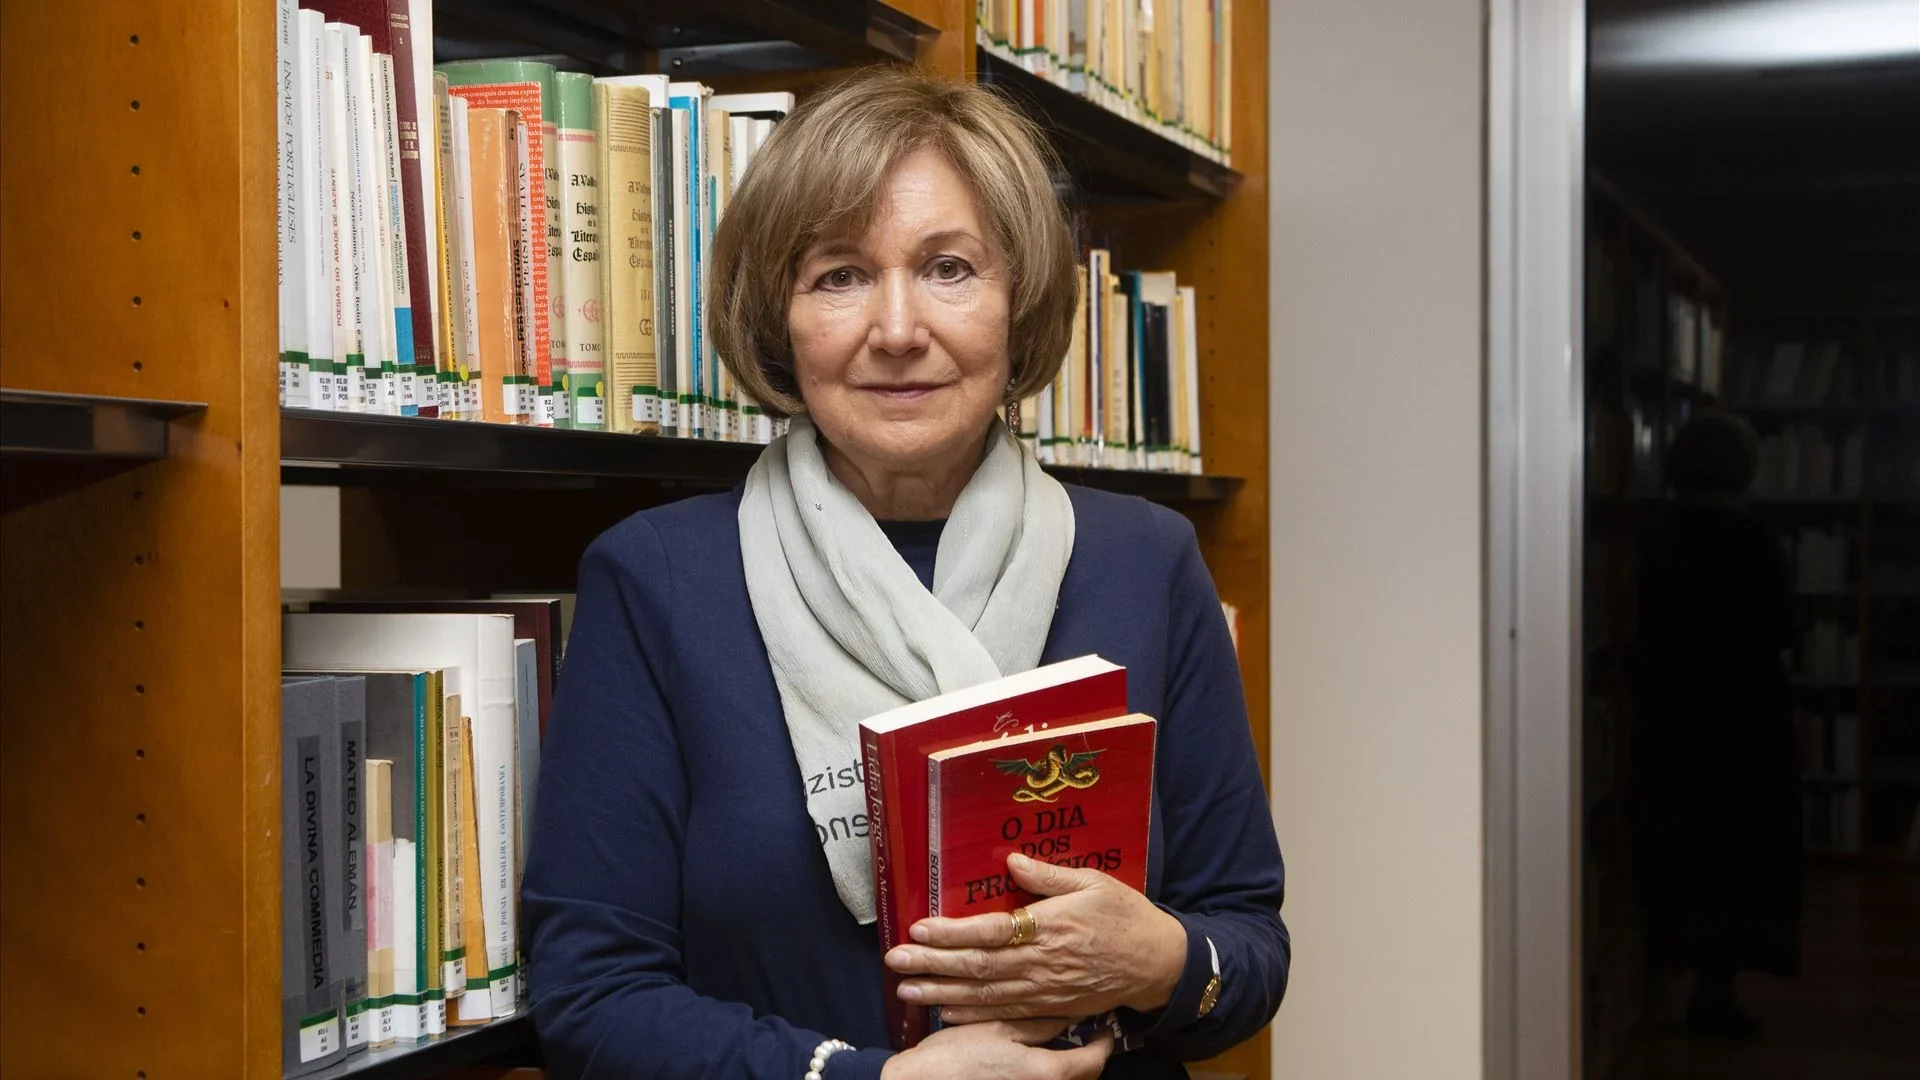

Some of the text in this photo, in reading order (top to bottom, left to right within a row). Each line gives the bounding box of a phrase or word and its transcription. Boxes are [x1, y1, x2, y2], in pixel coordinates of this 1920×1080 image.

[284, 60, 293, 126] ENSAIOS
[286, 132, 297, 244] PORTUGUESES
[333, 214, 338, 226] DE
[520, 163, 530, 287] PERSPECTIVAS
[334, 268, 340, 282] DO
[513, 240, 524, 341] PERSPECTIVAS
[804, 758, 864, 795] zist
[866, 743, 881, 792] Lídia
[346, 740, 359, 910] MATEO ALEMÁN
[421, 801, 424, 813] DE
[868, 790, 884, 848] Jorge
[1002, 804, 1088, 840] O DIA
[1020, 834, 1071, 858] DOS
[304, 756, 324, 990] LA DIVINA COMMEDIA
[878, 856, 884, 874] Os
[422, 904, 425, 916] DE
[438, 908, 443, 917] EL
[501, 931, 507, 942] DA
